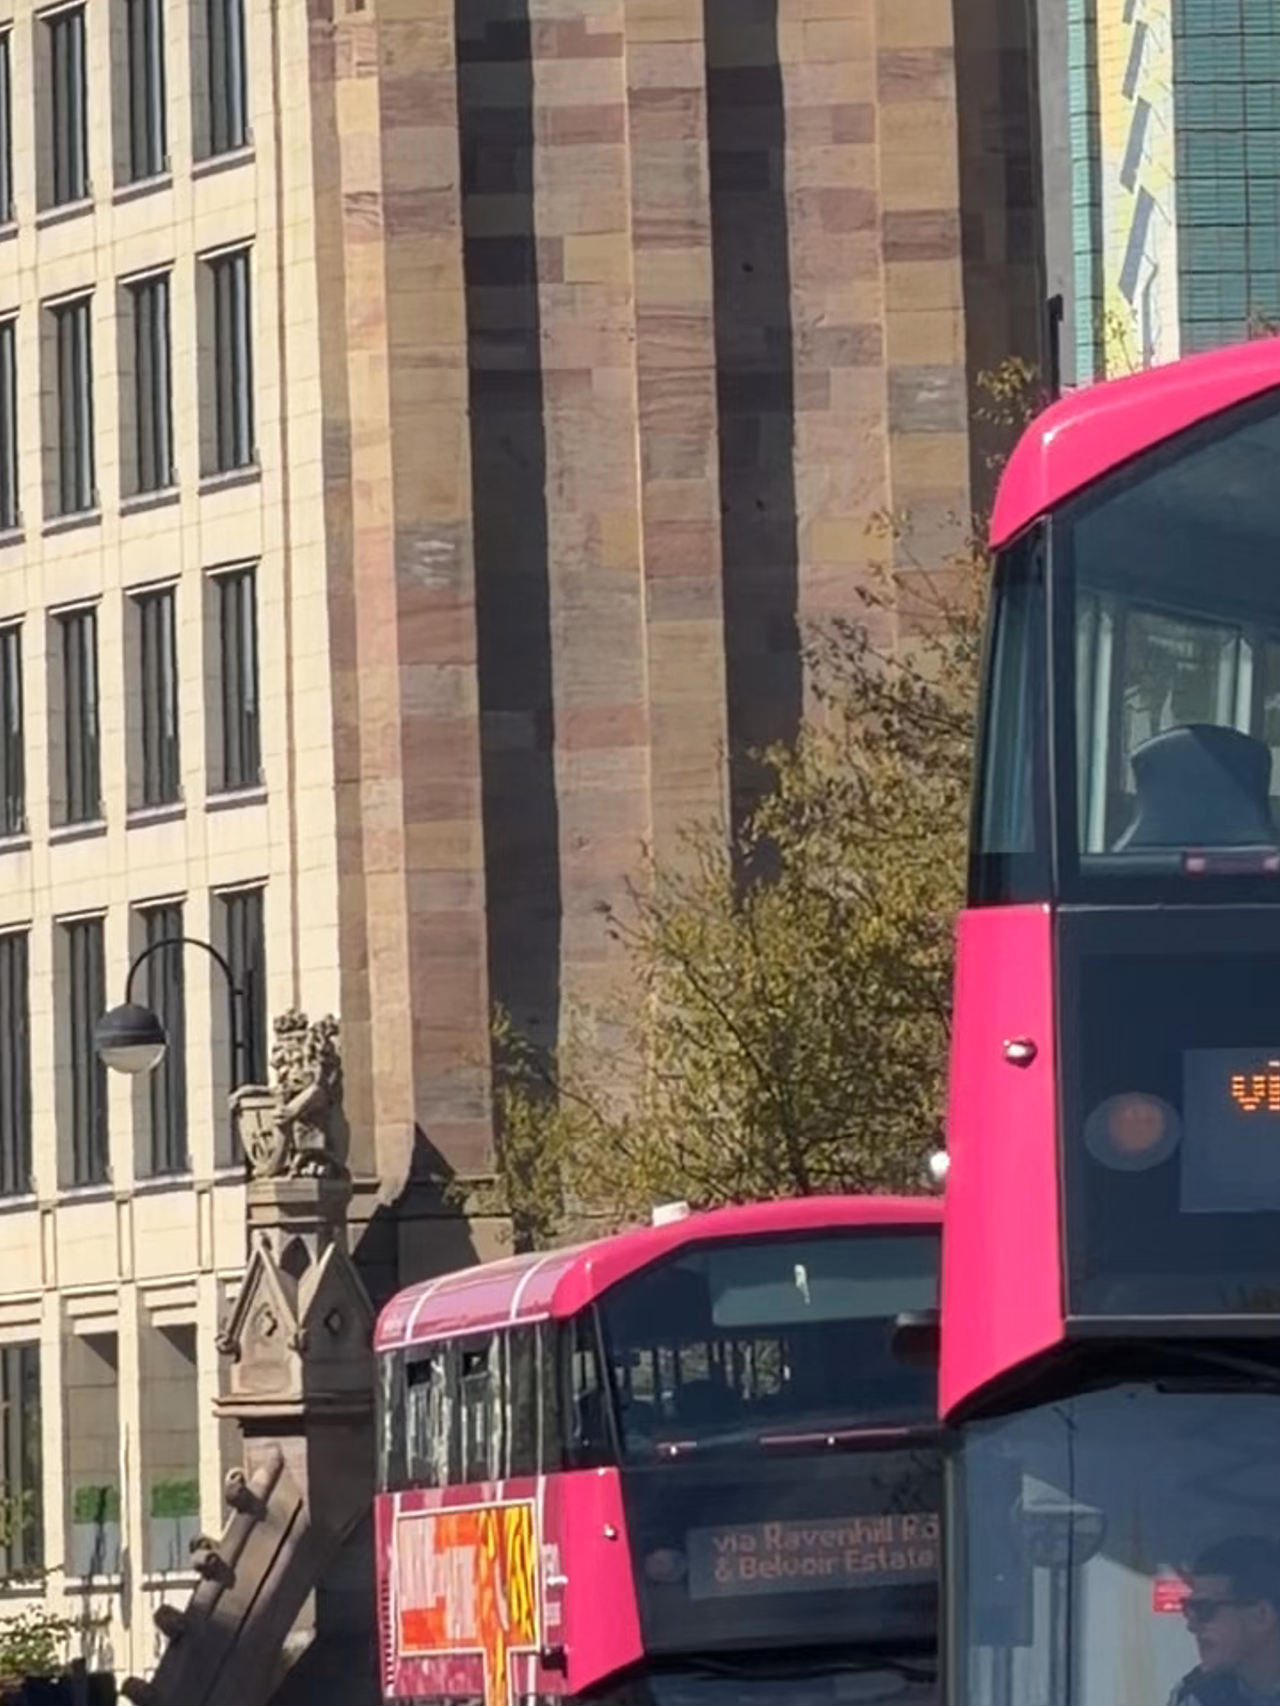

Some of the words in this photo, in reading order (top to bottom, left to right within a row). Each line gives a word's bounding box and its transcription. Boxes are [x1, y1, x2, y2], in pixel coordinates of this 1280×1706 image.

[713, 1531, 756, 1554] via
[764, 1517, 893, 1551] Ravenhill
[714, 1558, 732, 1584] &
